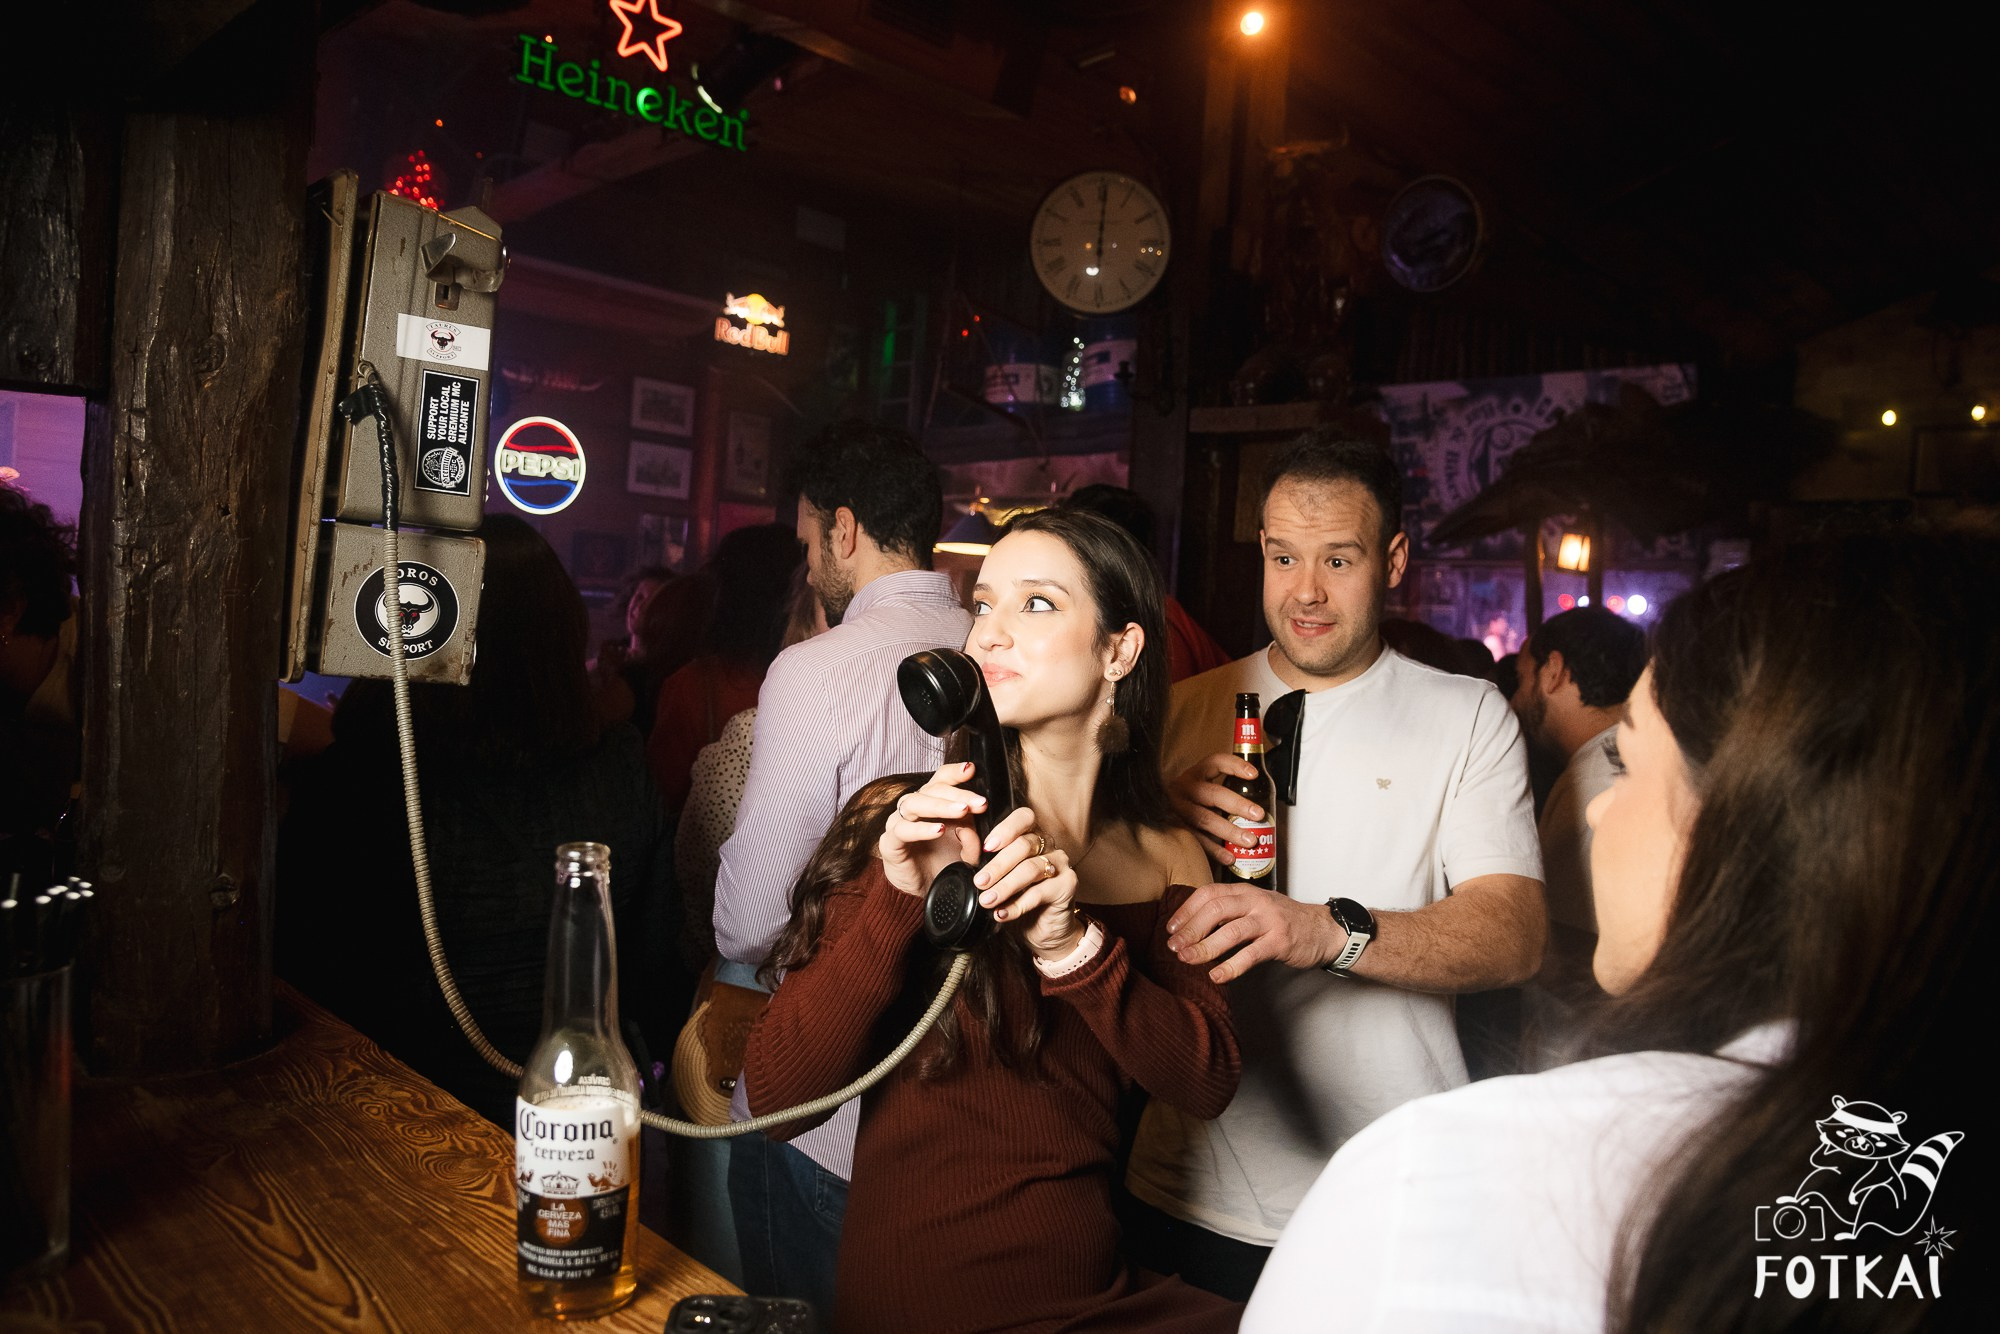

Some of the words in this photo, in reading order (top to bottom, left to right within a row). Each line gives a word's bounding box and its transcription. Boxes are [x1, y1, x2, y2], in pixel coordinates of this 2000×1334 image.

[517, 34, 748, 151] Heineken
[714, 317, 753, 348] Red
[752, 325, 790, 356] Bull
[440, 385, 451, 414] LOCAL
[451, 381, 462, 398] MC
[426, 396, 440, 440] SUPPORT
[437, 415, 448, 441] YOUR
[447, 399, 460, 443] GREMIUM
[458, 400, 470, 445] ALICANTE
[501, 449, 579, 481] PEPSI
[397, 567, 438, 586] OROS
[378, 637, 433, 654] SUPORT
[520, 1108, 613, 1142] Corona
[534, 1147, 595, 1161] cerveza
[537, 1208, 582, 1220] CERVEZA
[551, 1202, 566, 1211] LA
[547, 1219, 570, 1229] MAS
[547, 1228, 571, 1238] FINA
[562, 1249, 580, 1257] FROM
